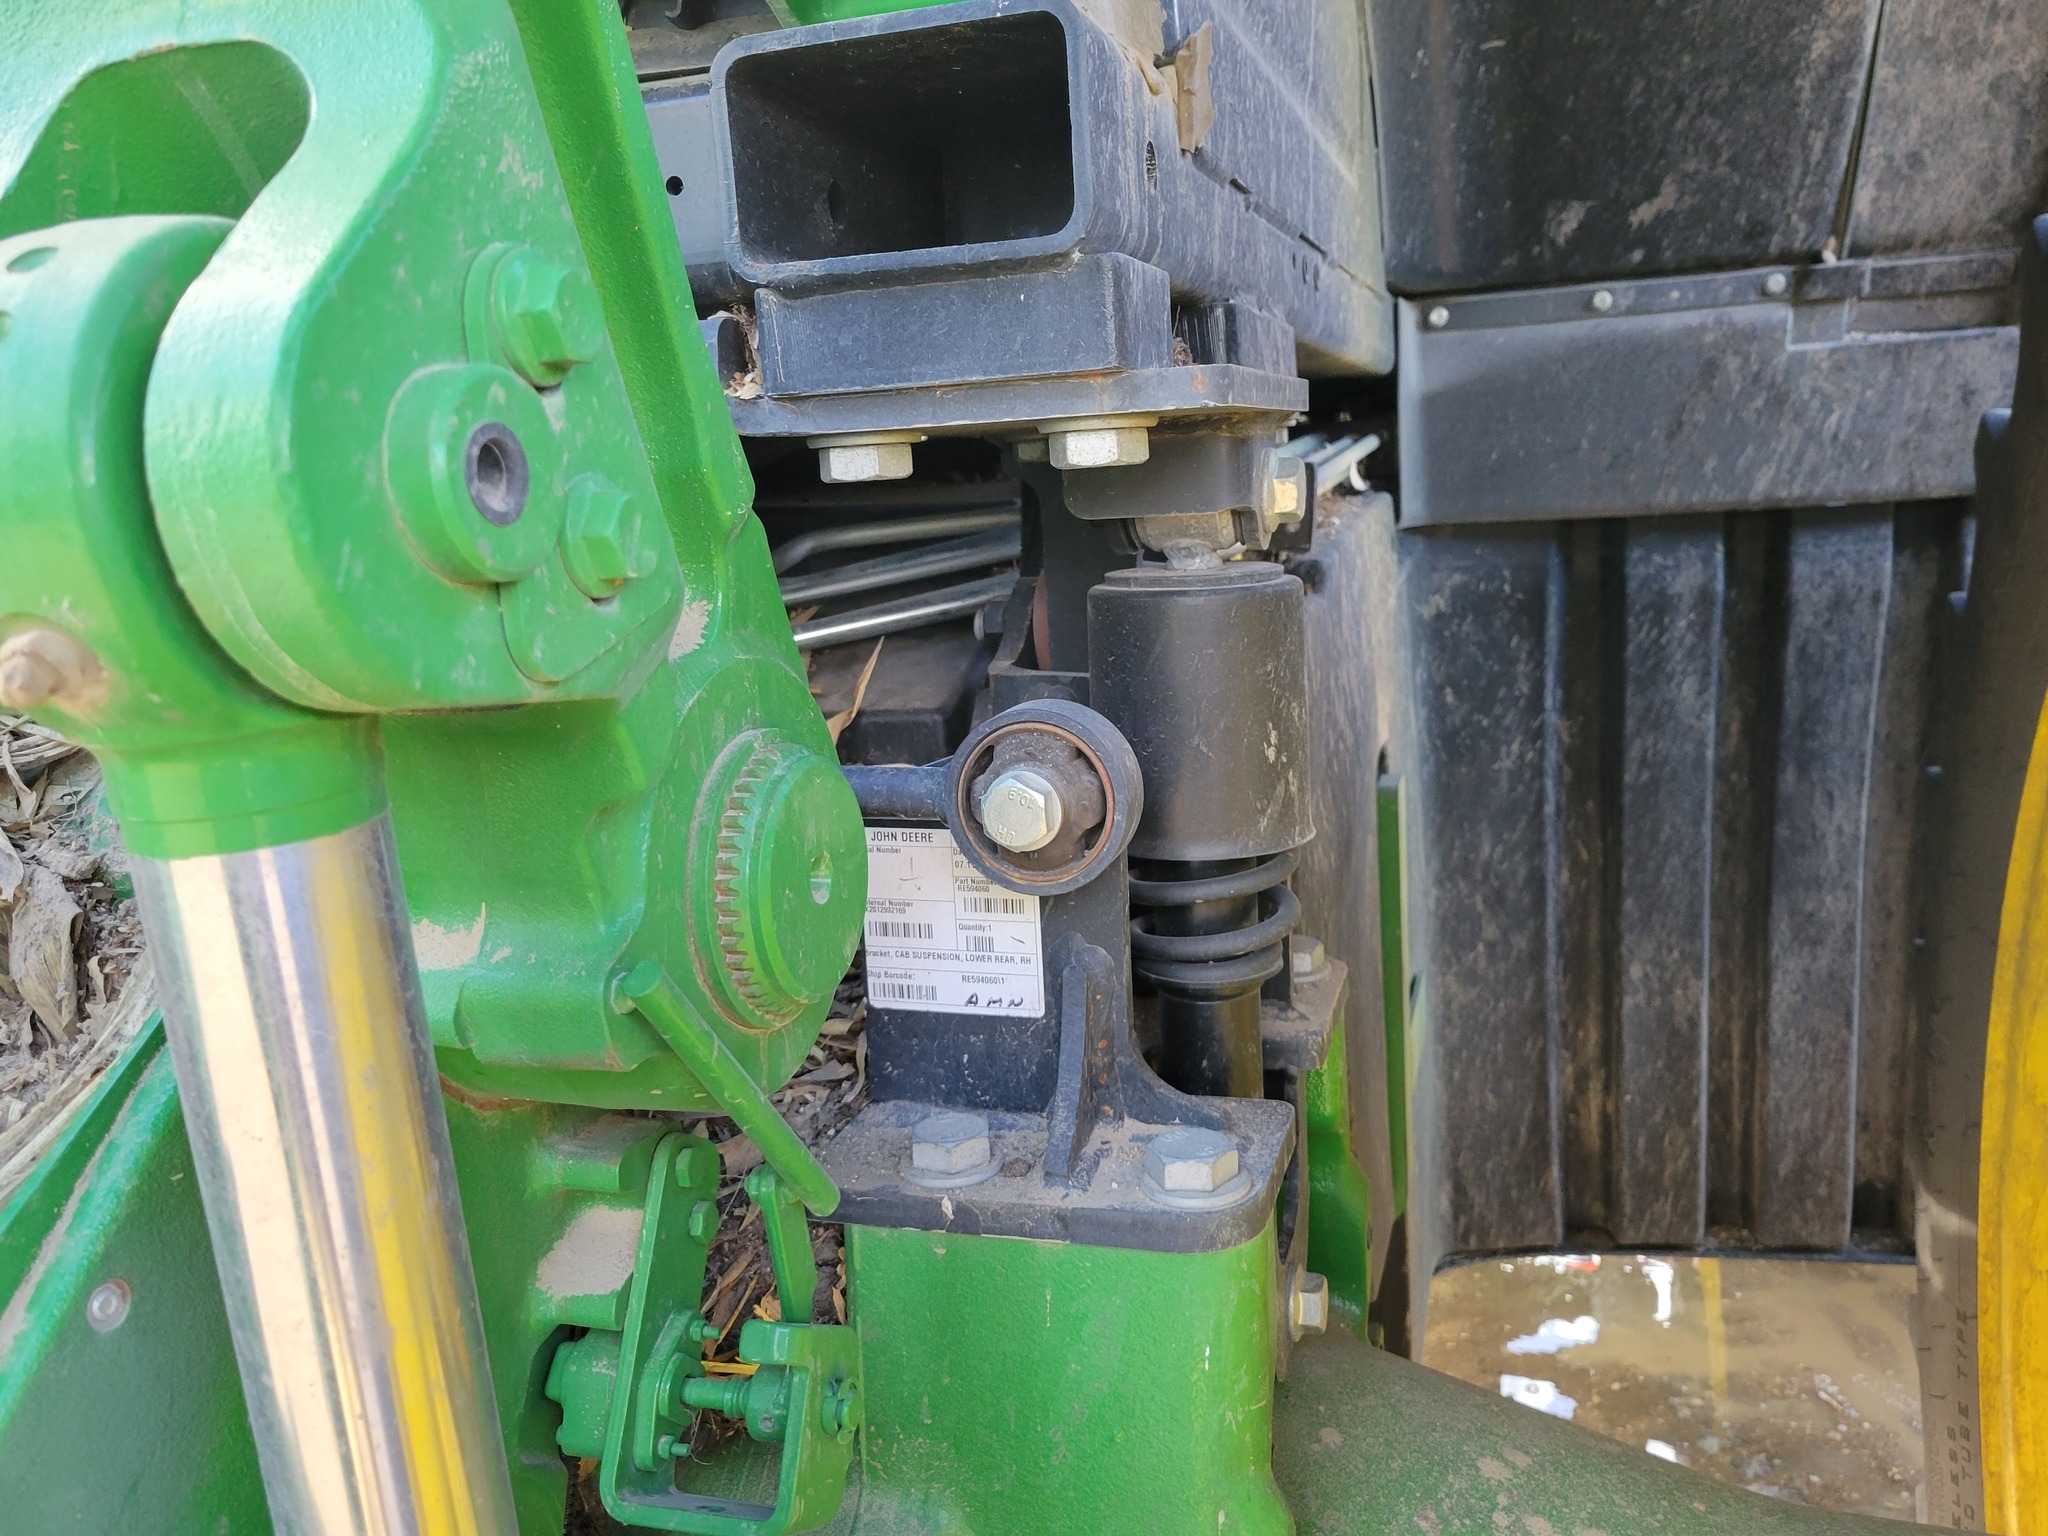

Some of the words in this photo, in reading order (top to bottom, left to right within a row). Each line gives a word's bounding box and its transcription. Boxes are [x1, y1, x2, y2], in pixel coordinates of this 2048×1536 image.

[871, 831, 897, 842] JOHN
[902, 832, 934, 843] DEERE
[876, 846, 901, 854] Number
[954, 877, 968, 885] Part
[888, 899, 914, 907] Number
[895, 950, 910, 958] CAB
[912, 950, 964, 962] SUSPENSION,
[965, 953, 993, 963] LOWER
[995, 955, 1018, 965] REAR,
[1020, 956, 1032, 965] RH
[884, 970, 916, 980] Barcode:
[1955, 1306, 1969, 1380] TYPE
[1958, 1400, 1972, 1481] TUBE
[1946, 1424, 1962, 1529] ELESS
